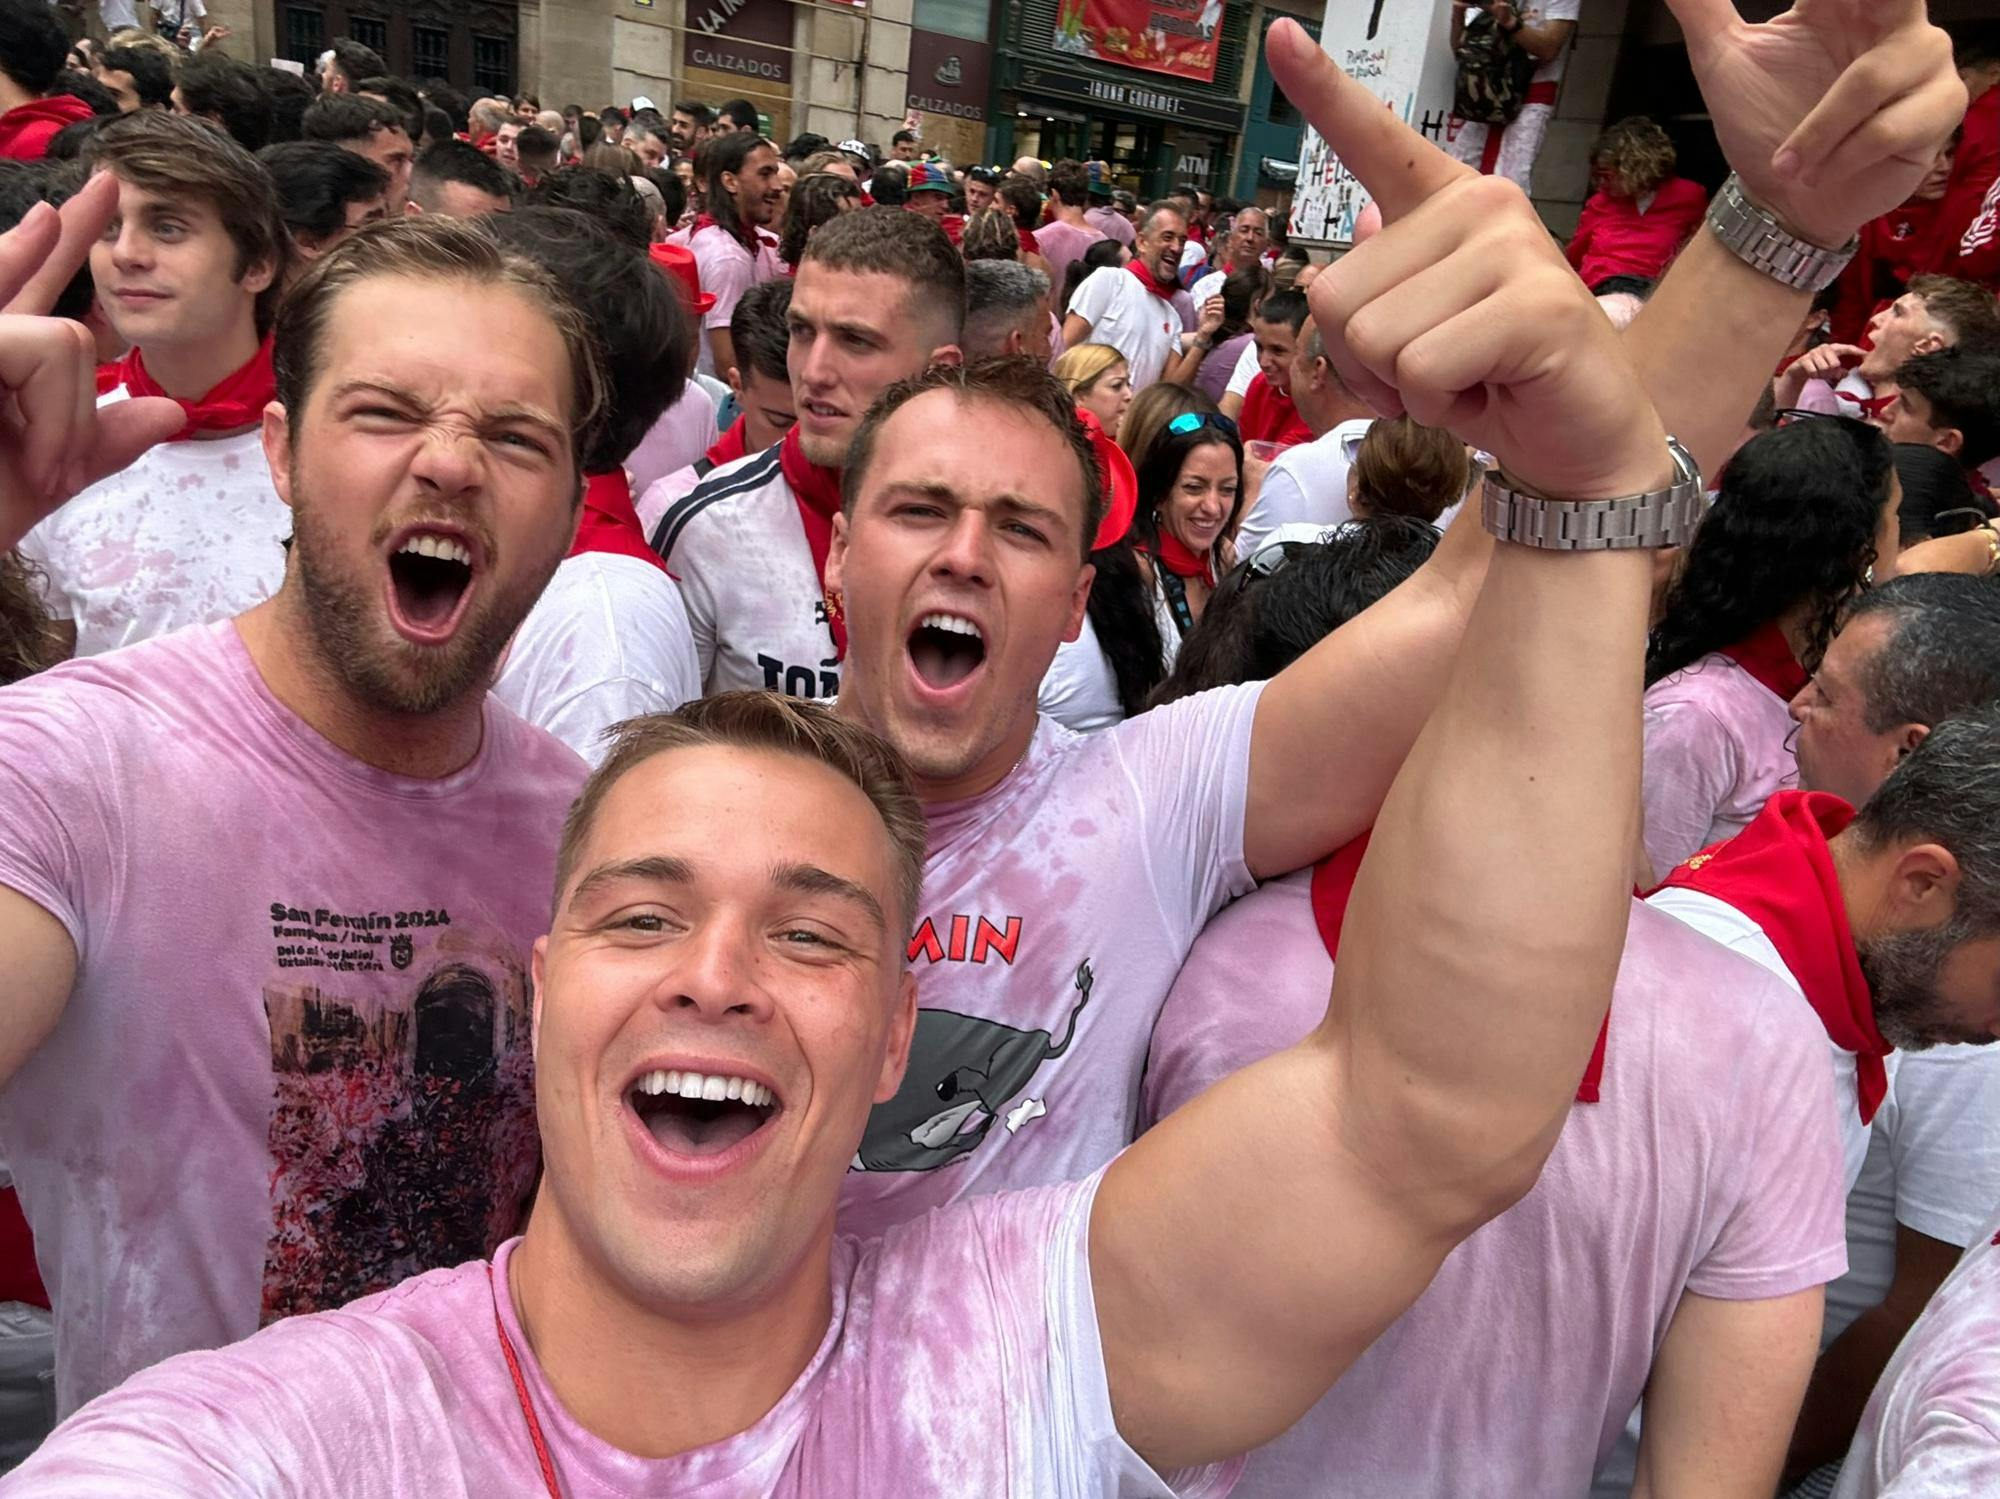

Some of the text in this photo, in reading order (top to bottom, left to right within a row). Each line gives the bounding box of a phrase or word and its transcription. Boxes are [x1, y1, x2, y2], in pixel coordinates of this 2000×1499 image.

[697, 9, 726, 33] LA
[692, 50, 783, 79] CALZADOS
[908, 95, 983, 119] CALZADOS
[1174, 154, 1210, 176] ATM
[270, 902, 452, 930] San Fermín 2024
[277, 945, 295, 957] Del
